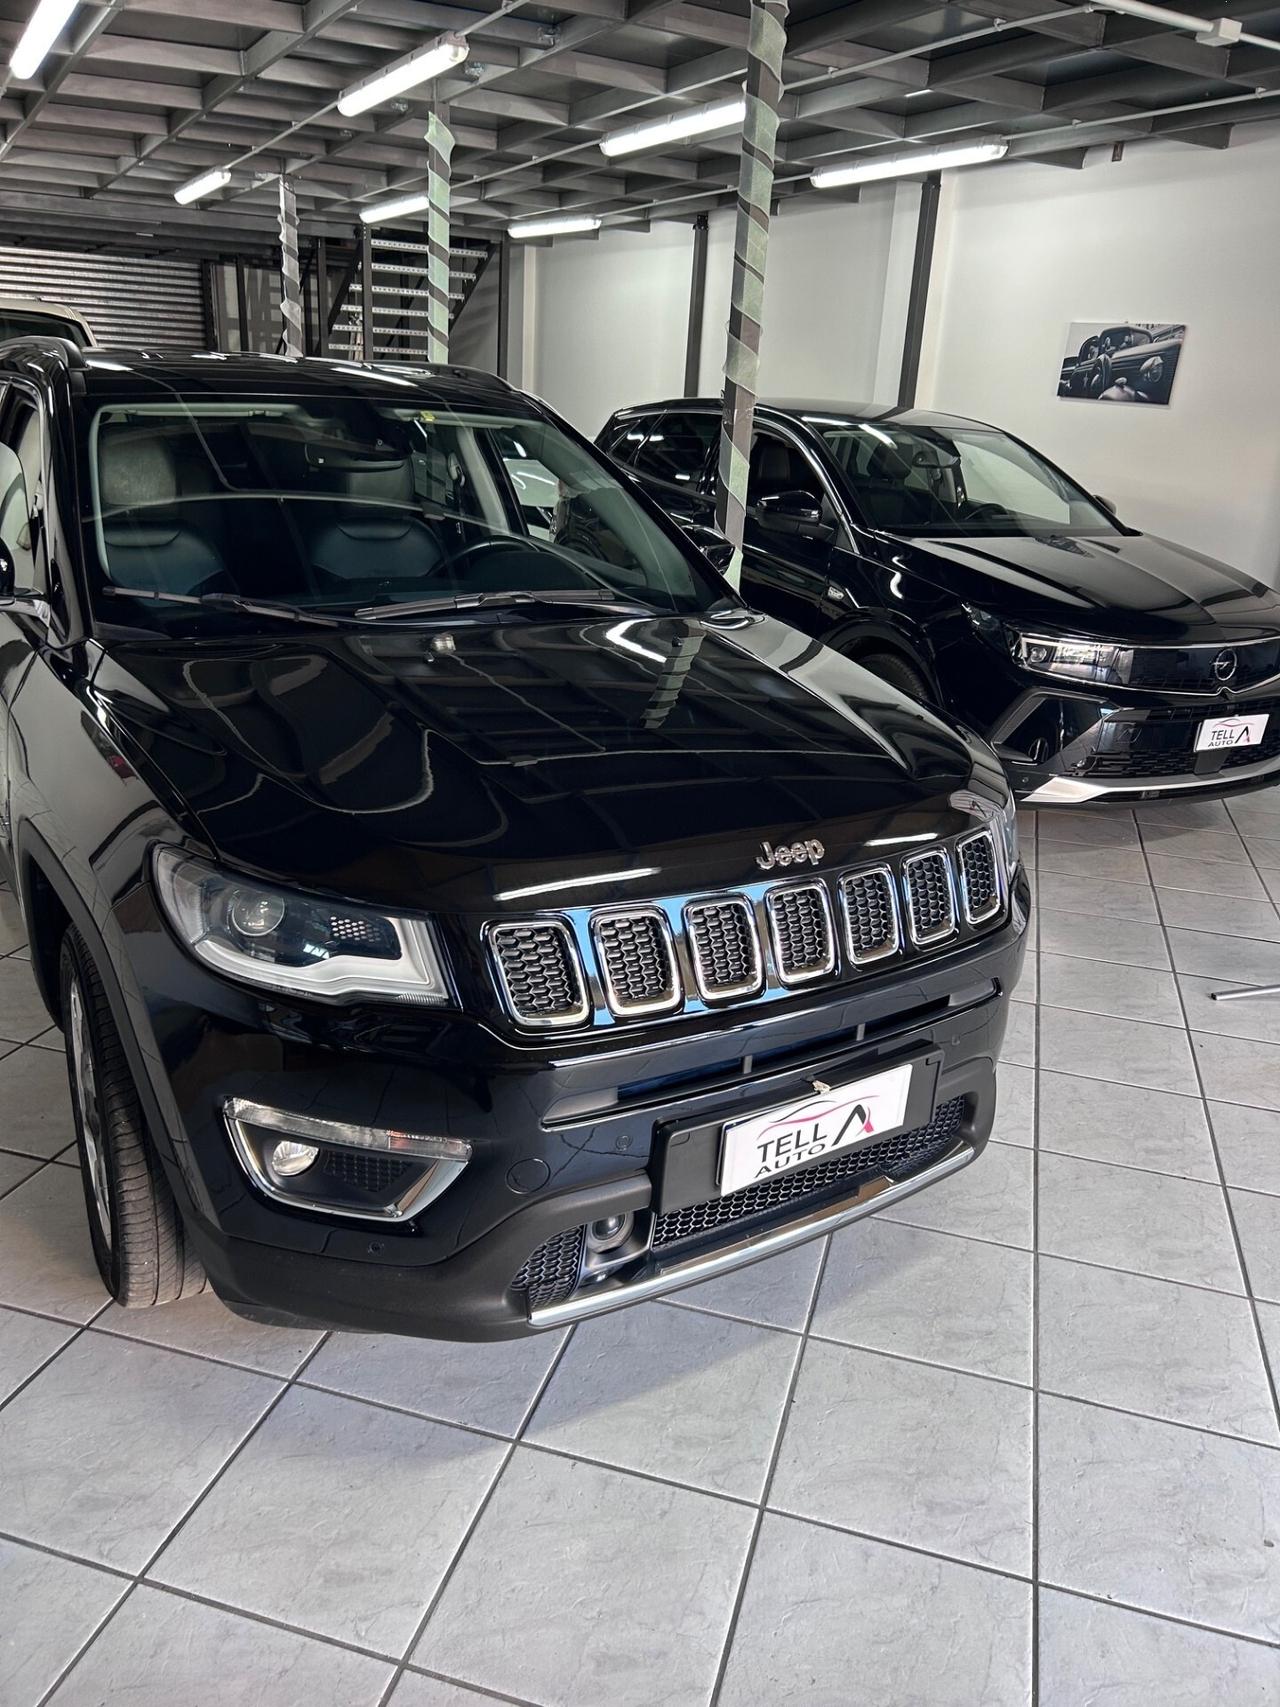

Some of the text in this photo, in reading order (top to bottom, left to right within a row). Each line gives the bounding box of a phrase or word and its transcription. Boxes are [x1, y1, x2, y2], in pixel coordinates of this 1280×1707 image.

[1208, 740, 1233, 748] AUTO
[755, 839, 825, 870] Jeep
[754, 1143, 826, 1178] AUTO
